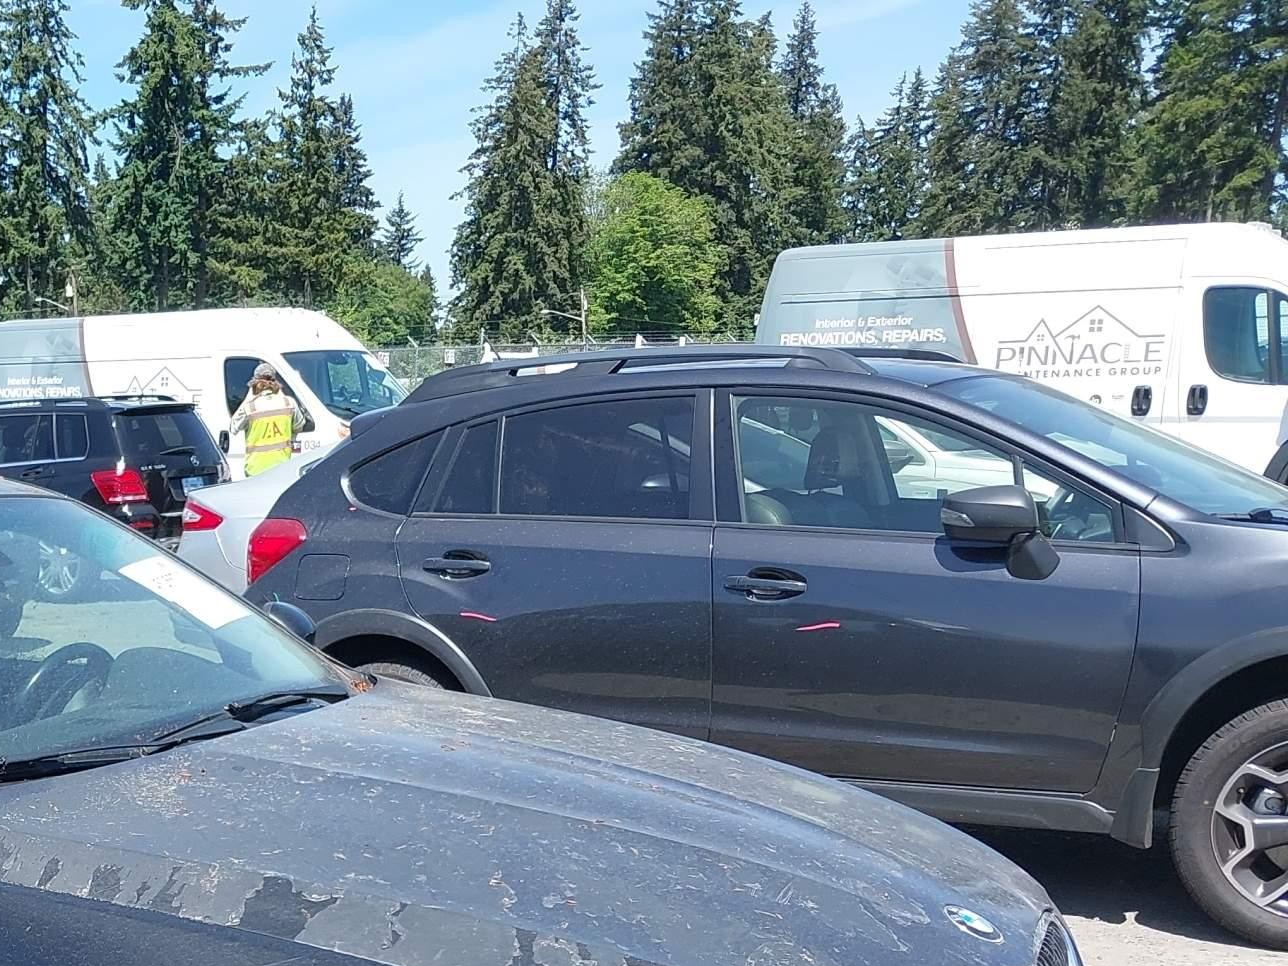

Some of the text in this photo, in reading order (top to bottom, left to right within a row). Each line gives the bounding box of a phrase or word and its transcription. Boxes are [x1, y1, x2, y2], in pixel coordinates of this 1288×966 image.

[815, 315, 913, 329] Interior & Exterior
[780, 328, 947, 346] RENOVATIONS, REPAIRS,
[995, 340, 1165, 369] PINNACLE
[1017, 366, 1162, 379] NTENANCE GROUP
